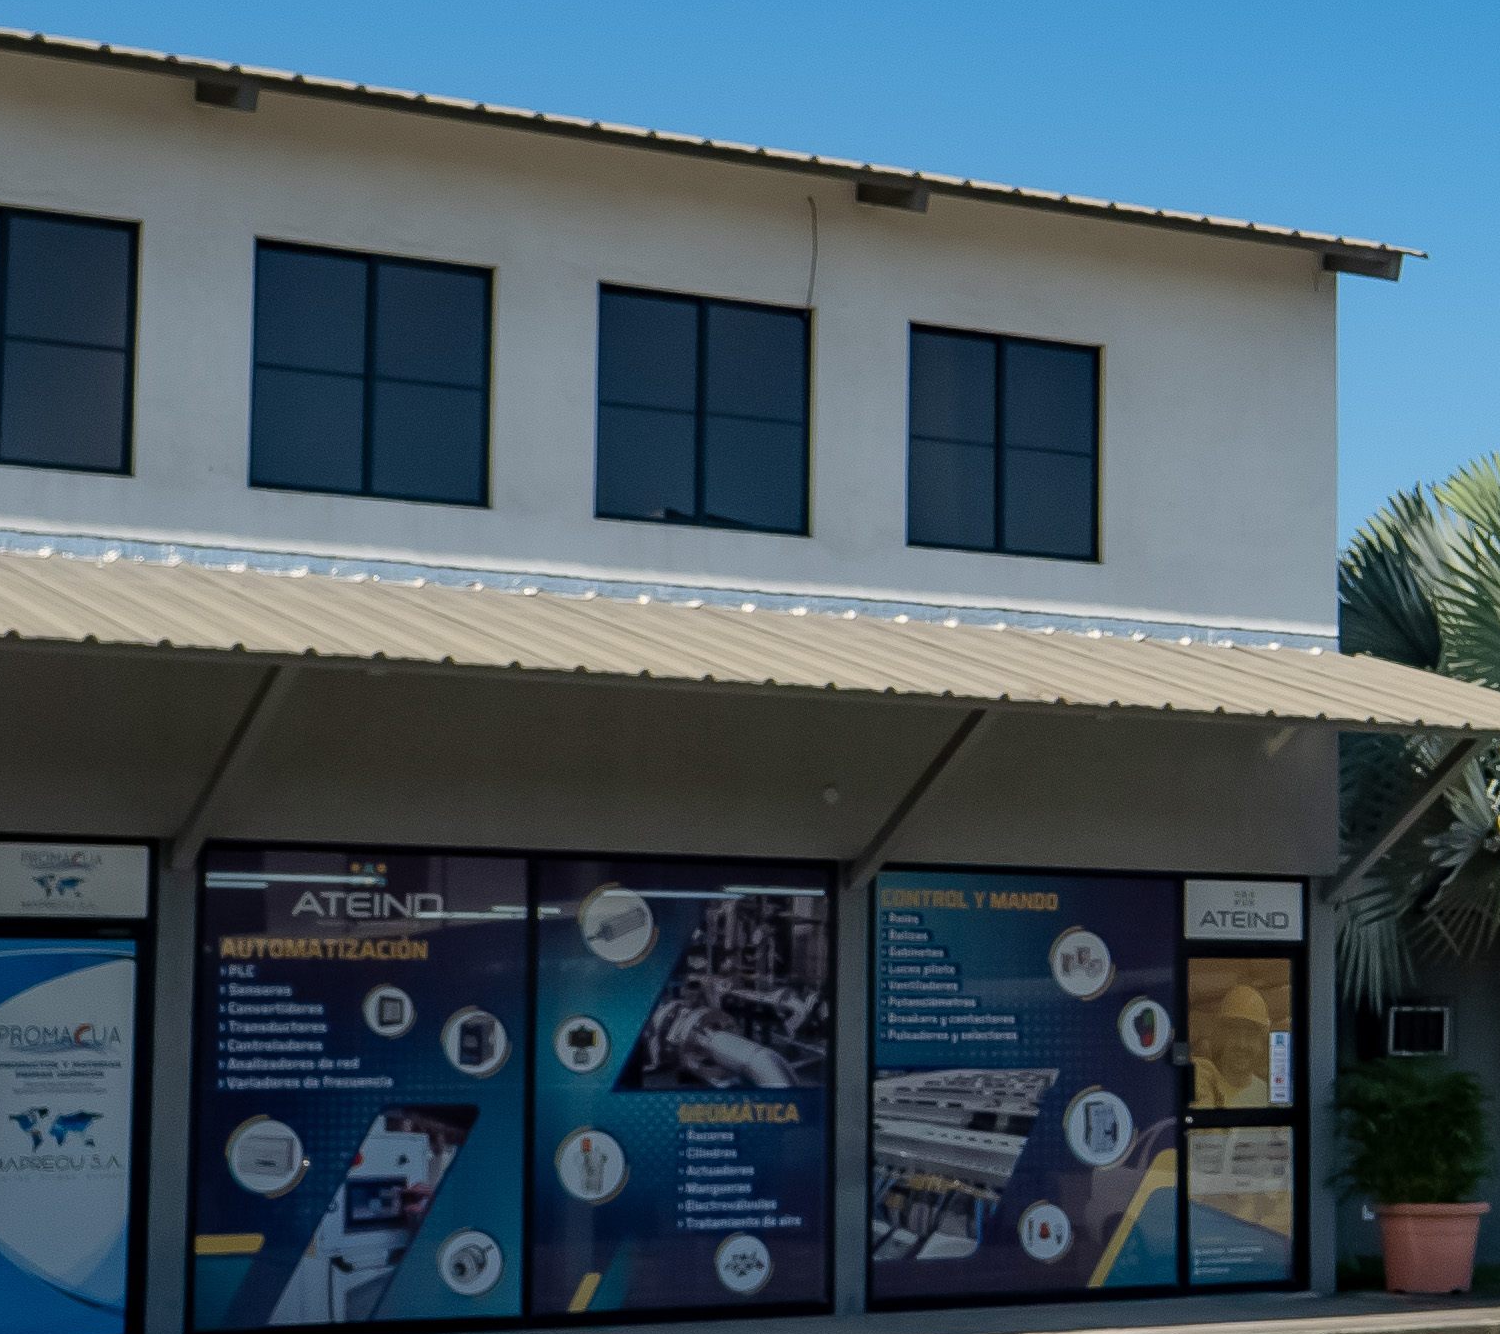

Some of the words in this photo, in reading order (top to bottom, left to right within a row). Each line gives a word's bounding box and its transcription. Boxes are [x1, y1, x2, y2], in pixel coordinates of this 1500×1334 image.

[292, 891, 445, 918] ATEIND
[881, 890, 968, 908] CONTROL
[973, 891, 985, 908] Y
[989, 892, 1059, 910] MANDO
[1200, 910, 1289, 930] ATEIND
[220, 936, 429, 960] AUTOMATIZACIÓN
[228, 983, 292, 997] Sensores
[888, 980, 958, 992] Ventiladores
[228, 1001, 324, 1015] Convertidores
[227, 1038, 324, 1052] Controladores
[318, 1058, 333, 1070] de
[336, 1056, 360, 1070] red
[227, 1076, 300, 1089] Variadores
[303, 1076, 319, 1089] de
